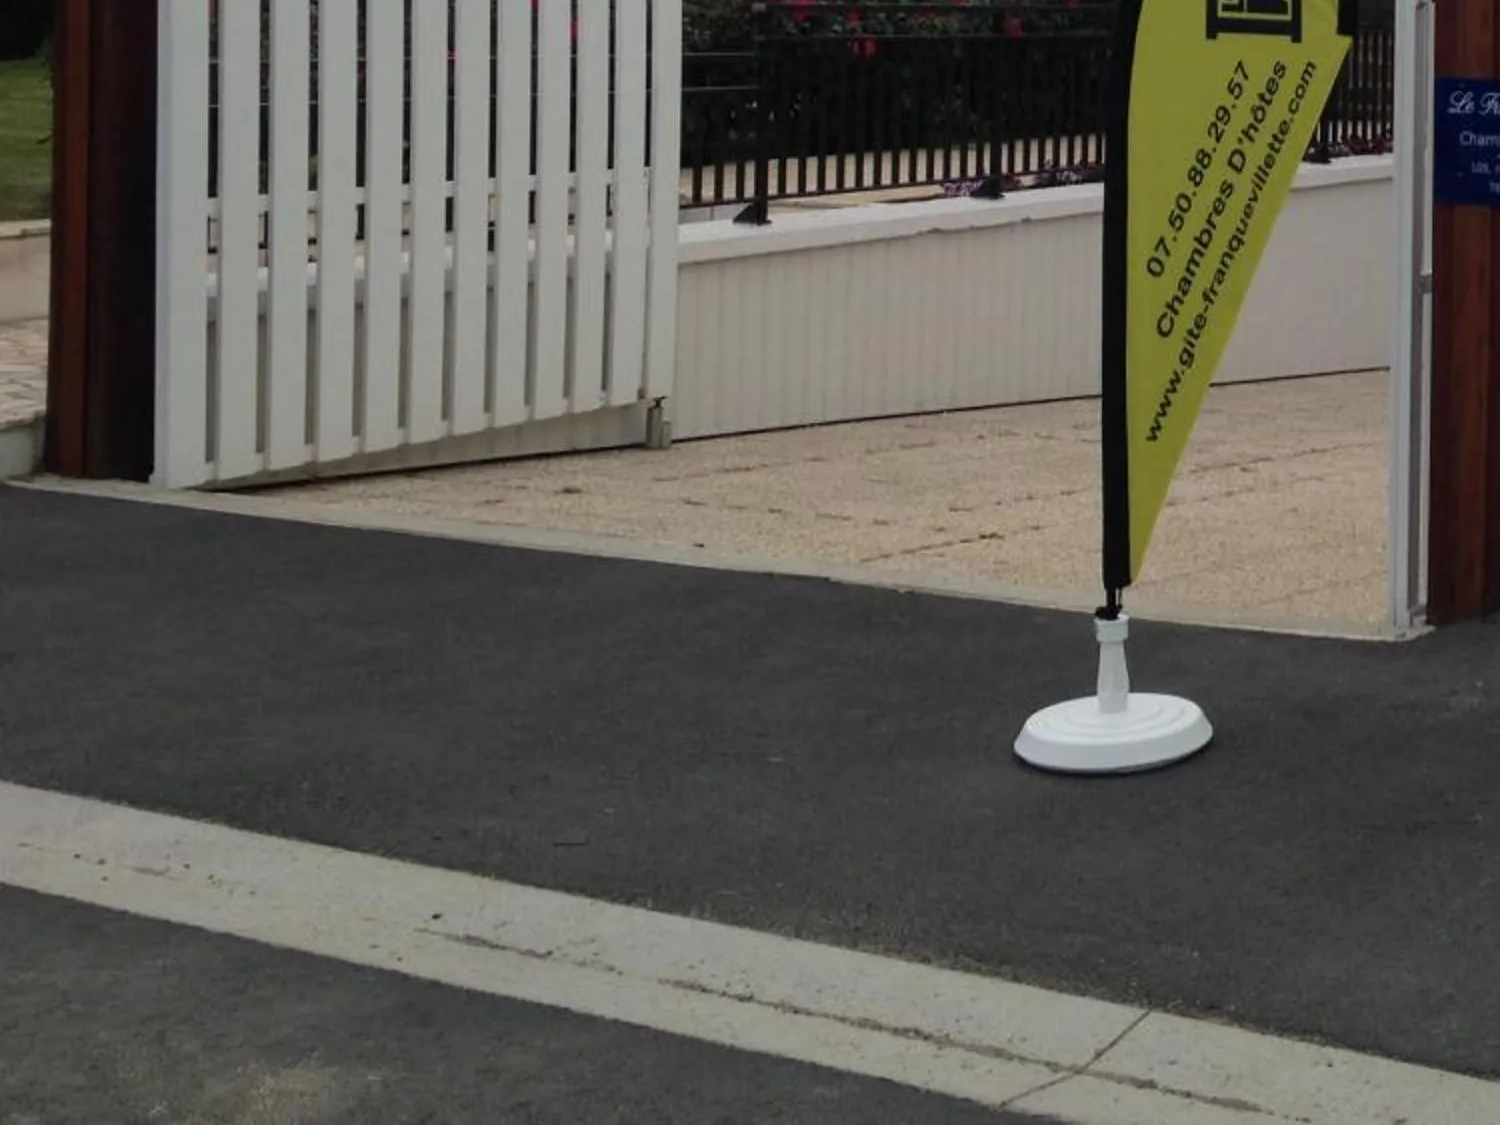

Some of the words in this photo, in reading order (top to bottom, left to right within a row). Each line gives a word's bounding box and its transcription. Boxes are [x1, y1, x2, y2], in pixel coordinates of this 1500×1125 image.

[1146, 59, 1250, 278] 07.50.88.29.57
[1156, 181, 1236, 339] Chambres
[1226, 59, 1288, 173] D'hôtes
[1446, 90, 1475, 115] Le
[1146, 59, 1317, 444] www.gite-franquevillette.com
